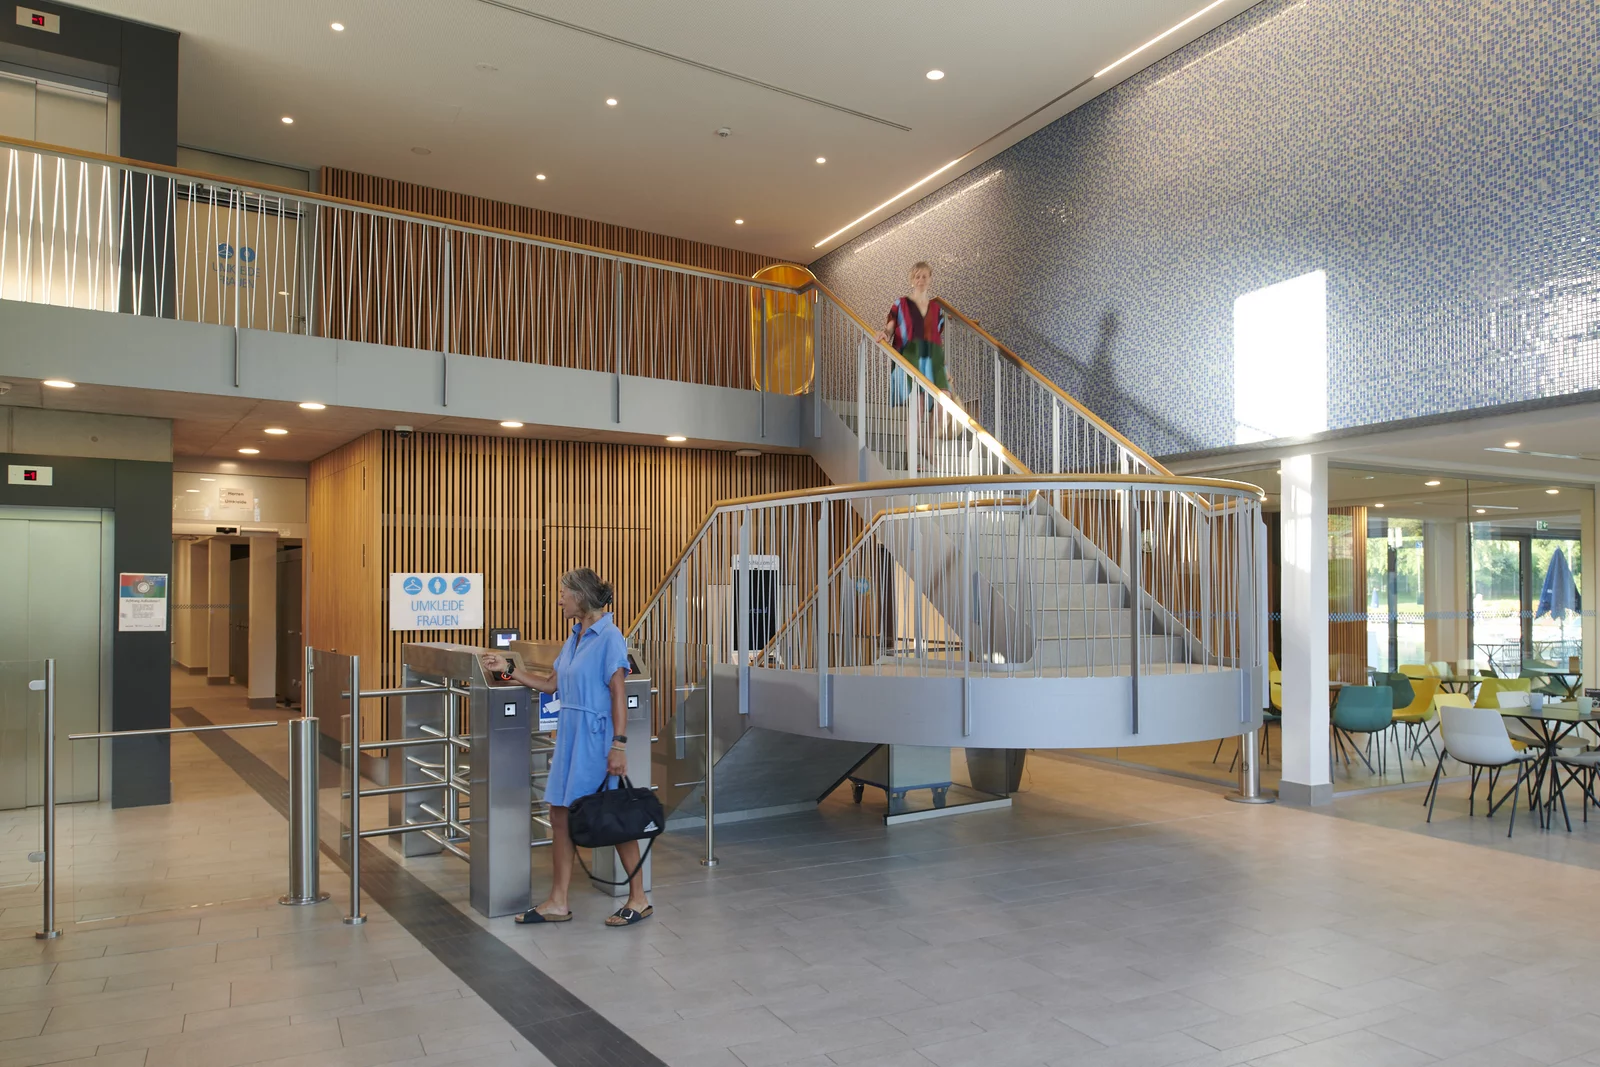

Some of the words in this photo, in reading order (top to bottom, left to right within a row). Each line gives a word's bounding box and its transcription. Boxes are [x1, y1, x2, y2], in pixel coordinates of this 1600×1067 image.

[32, 17, 43, 25] -1
[24, 472, 35, 480] -1
[411, 600, 464, 611] UMKLEIDE
[417, 615, 458, 626] FRAUEN
